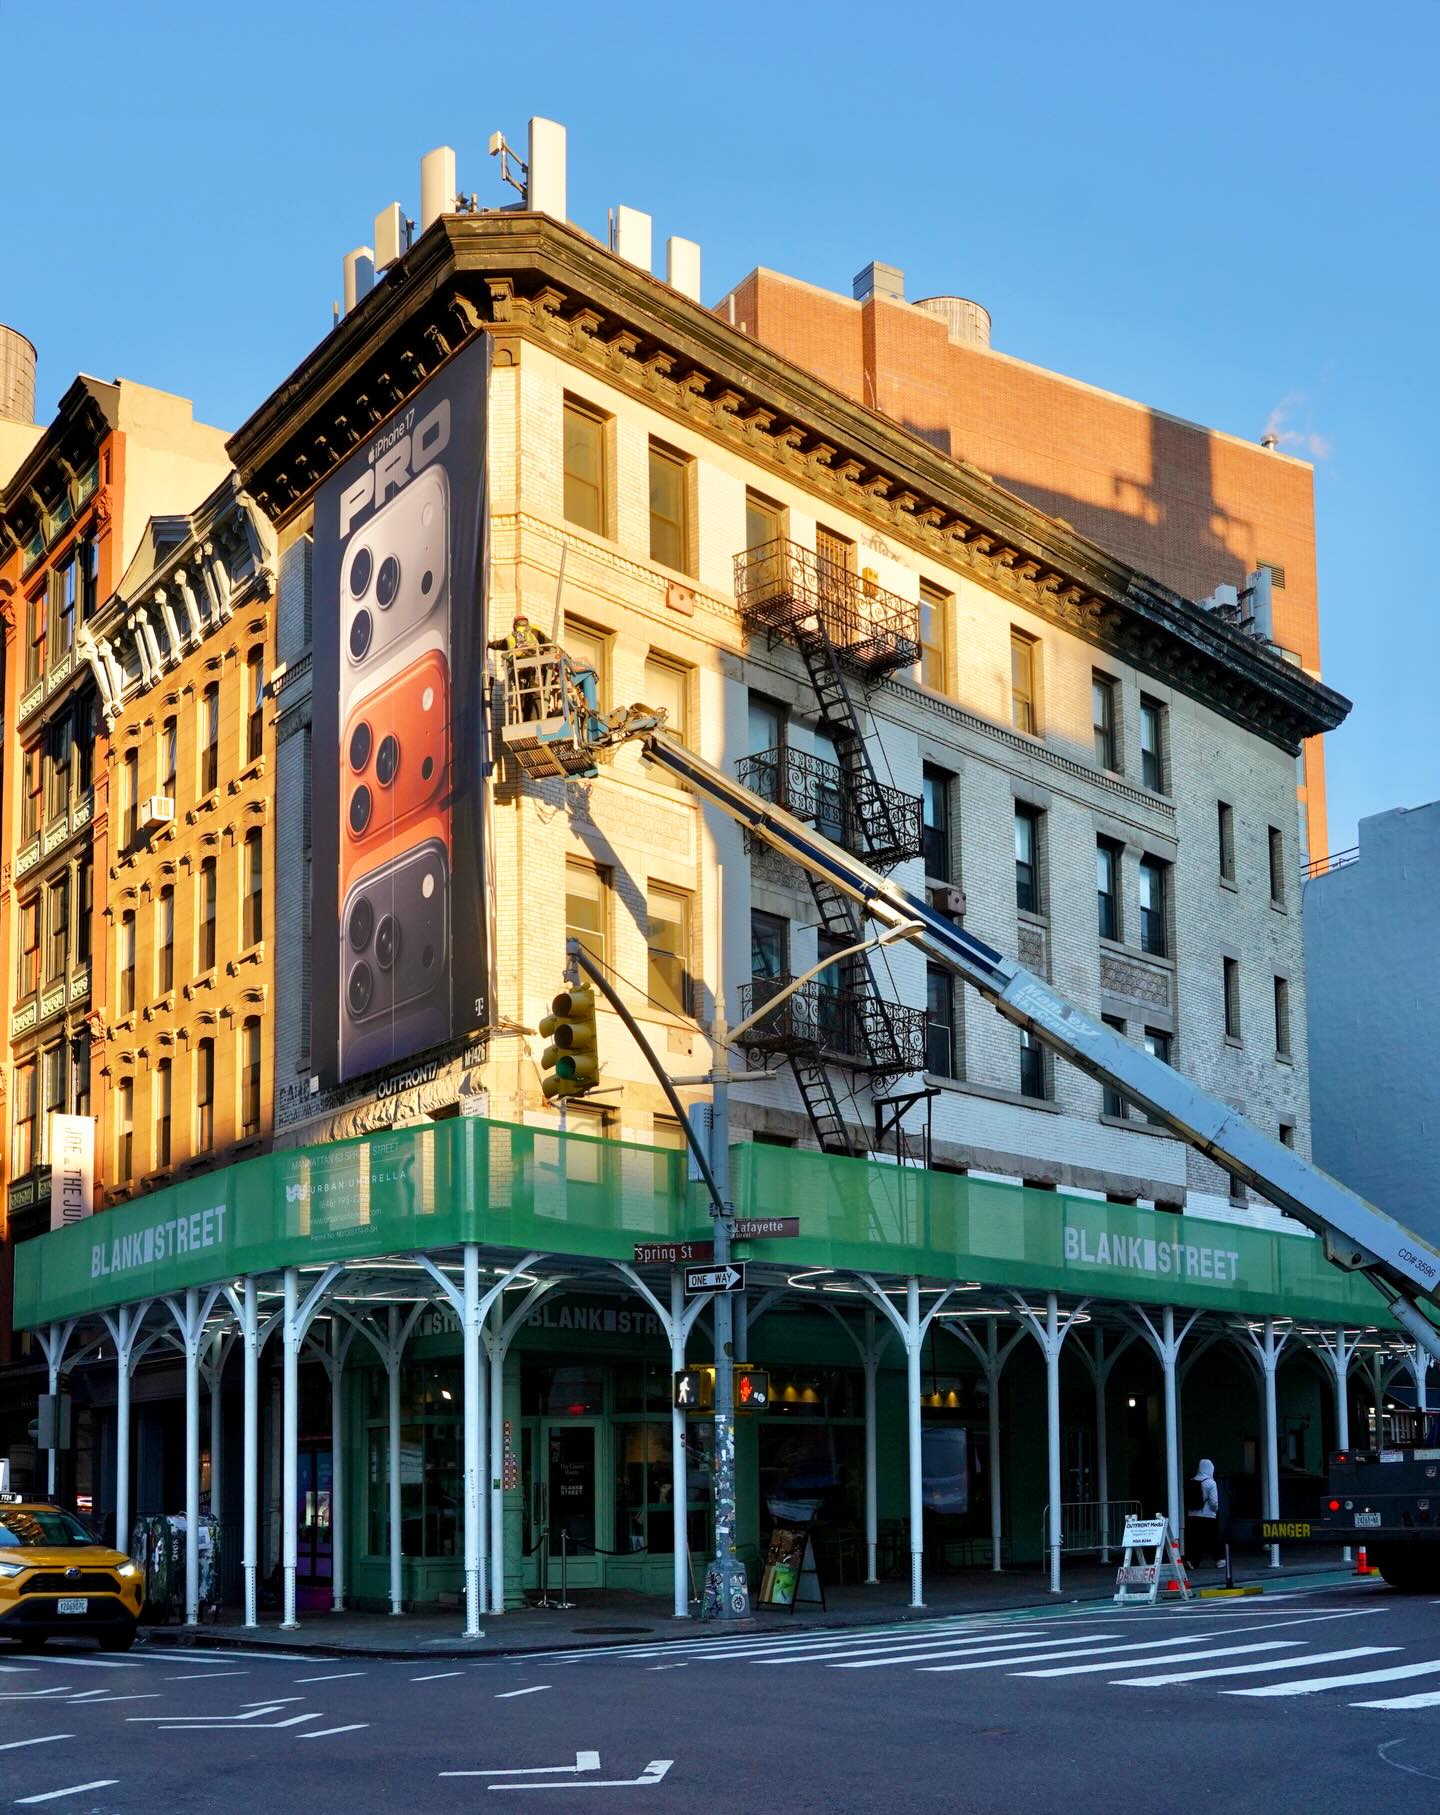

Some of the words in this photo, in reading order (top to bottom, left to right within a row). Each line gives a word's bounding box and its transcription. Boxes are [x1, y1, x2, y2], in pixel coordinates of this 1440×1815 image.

[375, 423, 405, 460] iPhone
[405, 407, 415, 430] 17
[339, 398, 451, 540] PRO
[1023, 982, 1092, 1033] Manex
[372, 1142, 399, 1156] STREET
[63, 1168, 82, 1195] THE
[311, 1181, 344, 1195] URBAN
[63, 1200, 82, 1226] JUI
[735, 1220, 784, 1234] Lafayette
[91, 1231, 143, 1278] BLANK
[154, 1204, 227, 1260] STREET
[636, 1246, 676, 1263] Spring
[681, 1245, 693, 1259] St
[1064, 1226, 1144, 1270] BLANK
[1157, 1241, 1240, 1281] STREET
[1398, 1248, 1436, 1278] CD#3596
[691, 1274, 707, 1286] ONE
[715, 1272, 733, 1284] WAY
[527, 1304, 604, 1331] BLANK
[1263, 1523, 1311, 1538] DANGER
[1118, 1567, 1156, 1583] DANGER
